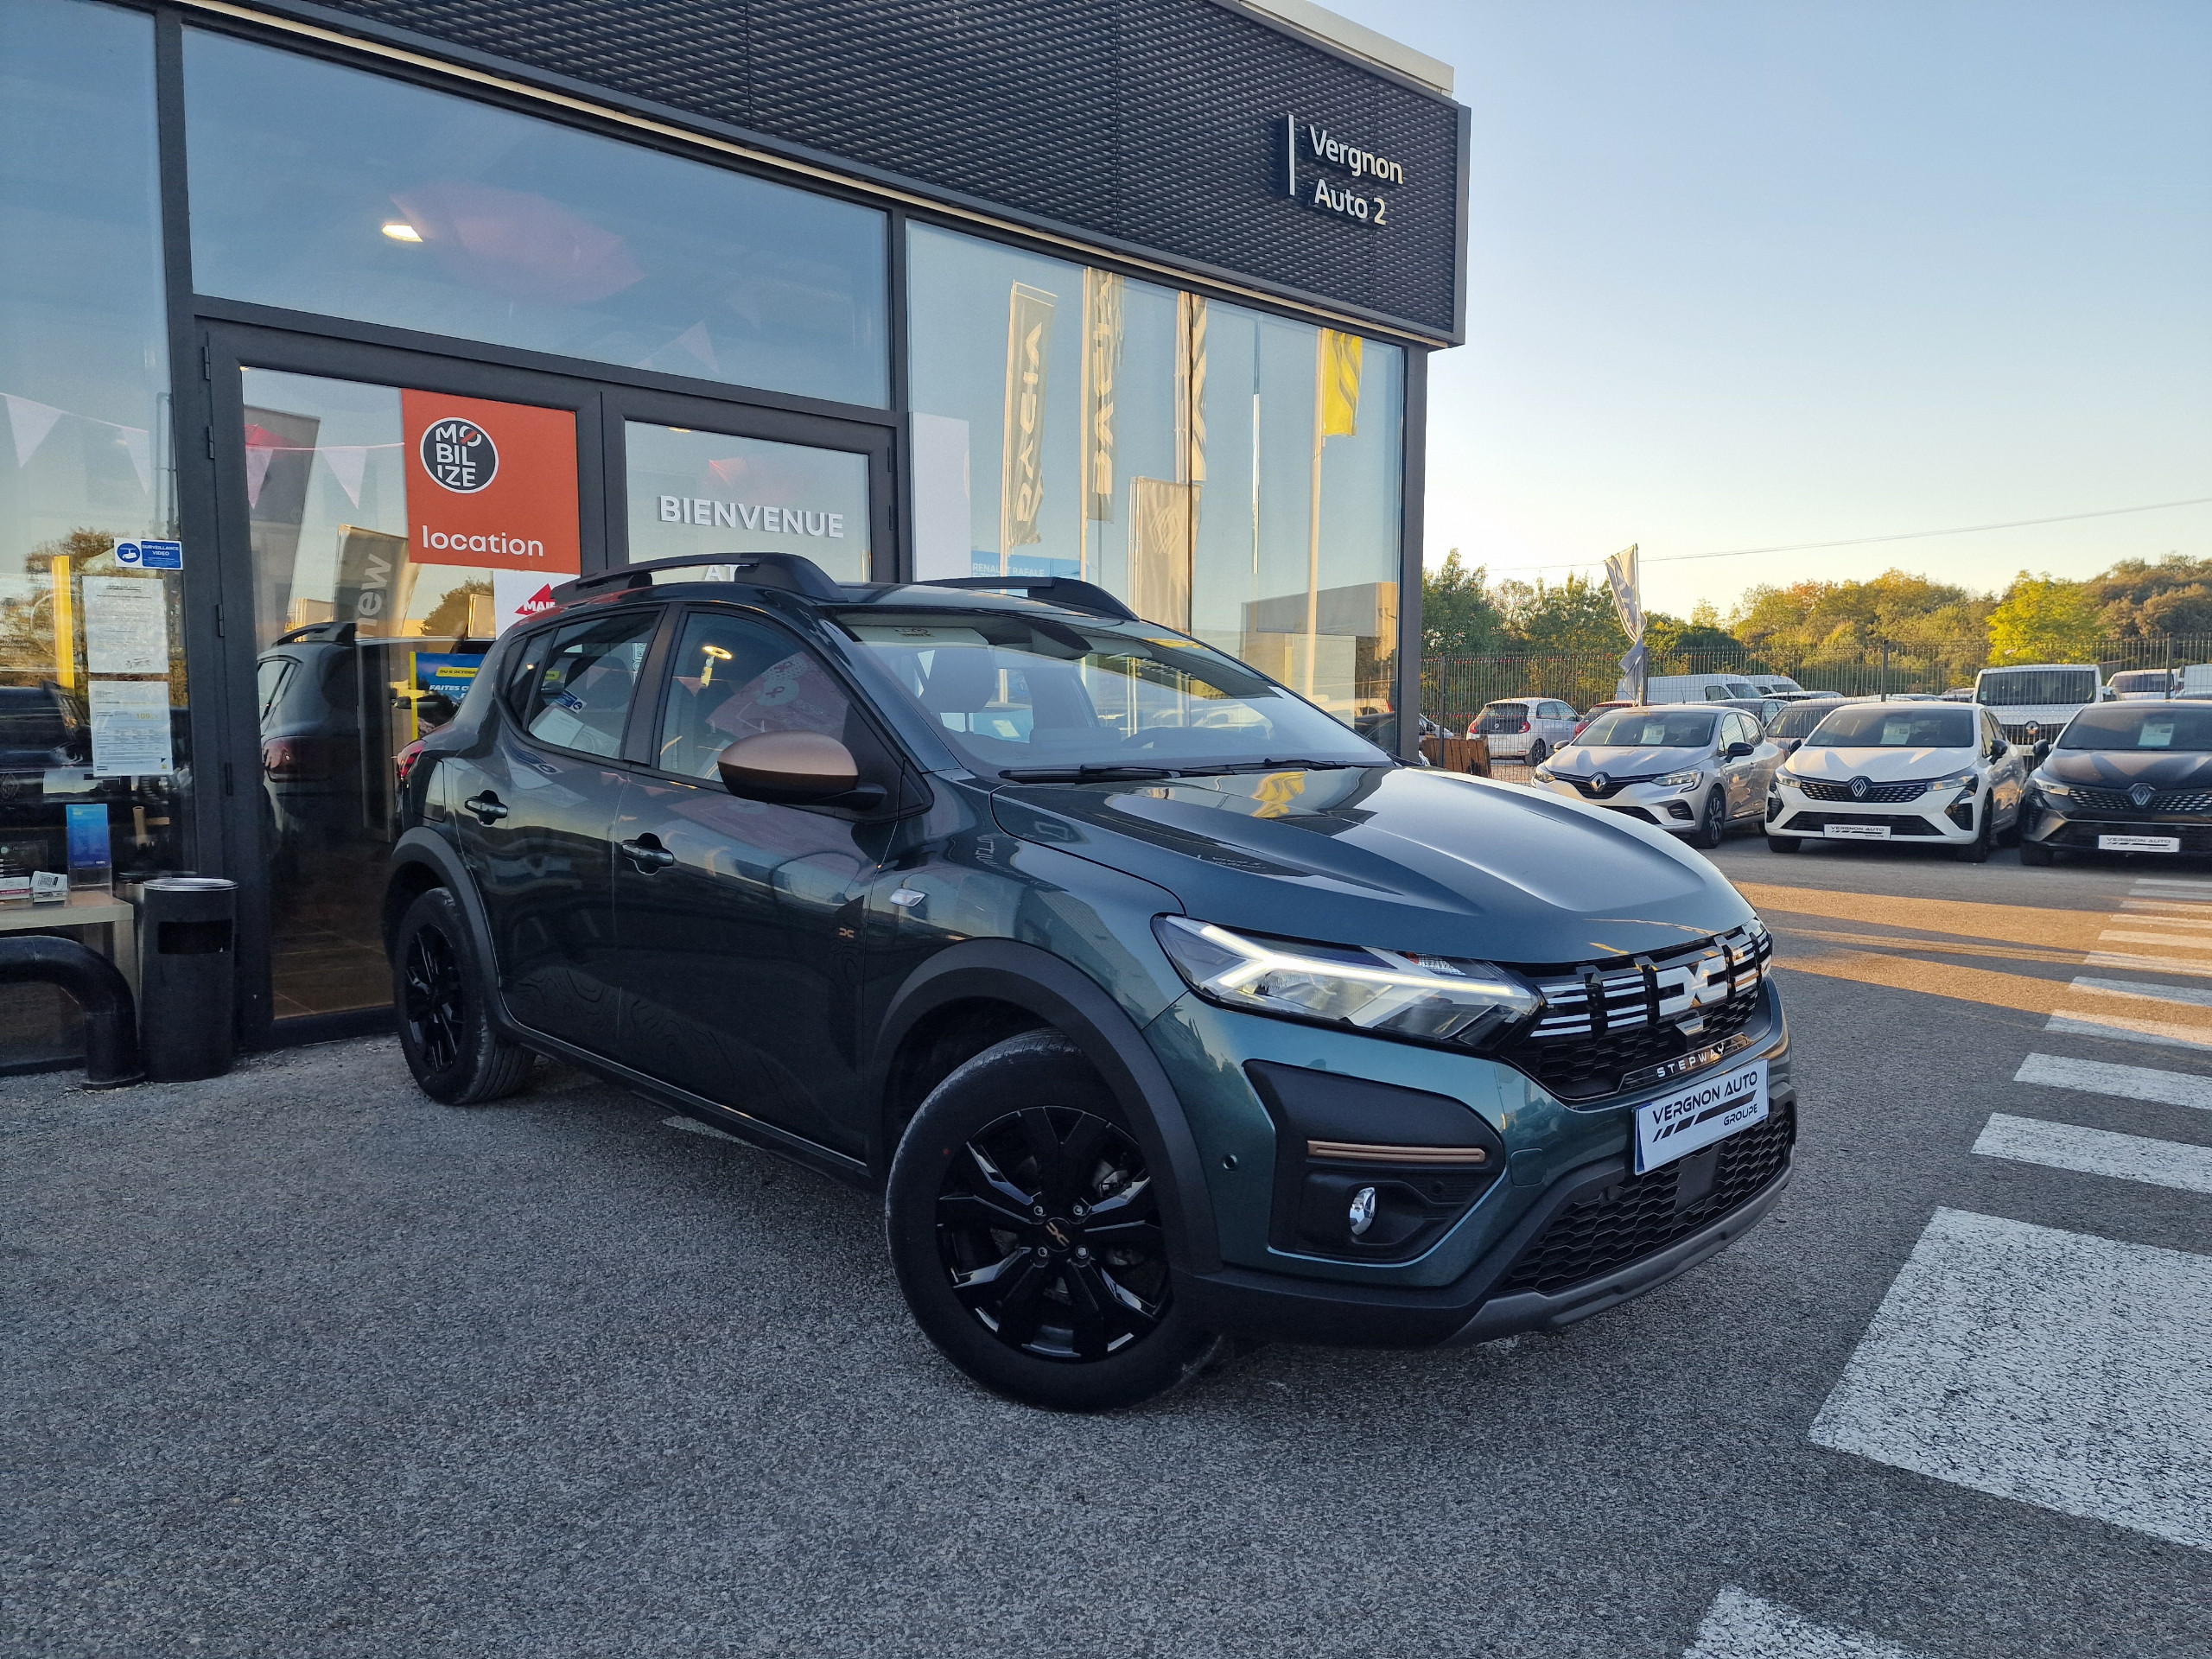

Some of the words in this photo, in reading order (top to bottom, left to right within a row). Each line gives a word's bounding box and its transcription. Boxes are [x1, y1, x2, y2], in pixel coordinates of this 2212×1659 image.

[1309, 124, 1403, 184] Vergnon
[1315, 179, 1368, 219] Auto
[1374, 198, 1386, 225] 2
[659, 495, 844, 538] BIENVENUE
[422, 524, 543, 557] location
[973, 563, 1011, 574] RENAUT
[1013, 567, 1045, 577] RAFALE
[354, 553, 391, 638] new
[1656, 1041, 1726, 1077] STEPWAY
[1652, 1085, 1719, 1124] VERGNON
[1724, 1071, 1758, 1096] AUTO
[1723, 1103, 1758, 1126] GROUPE
